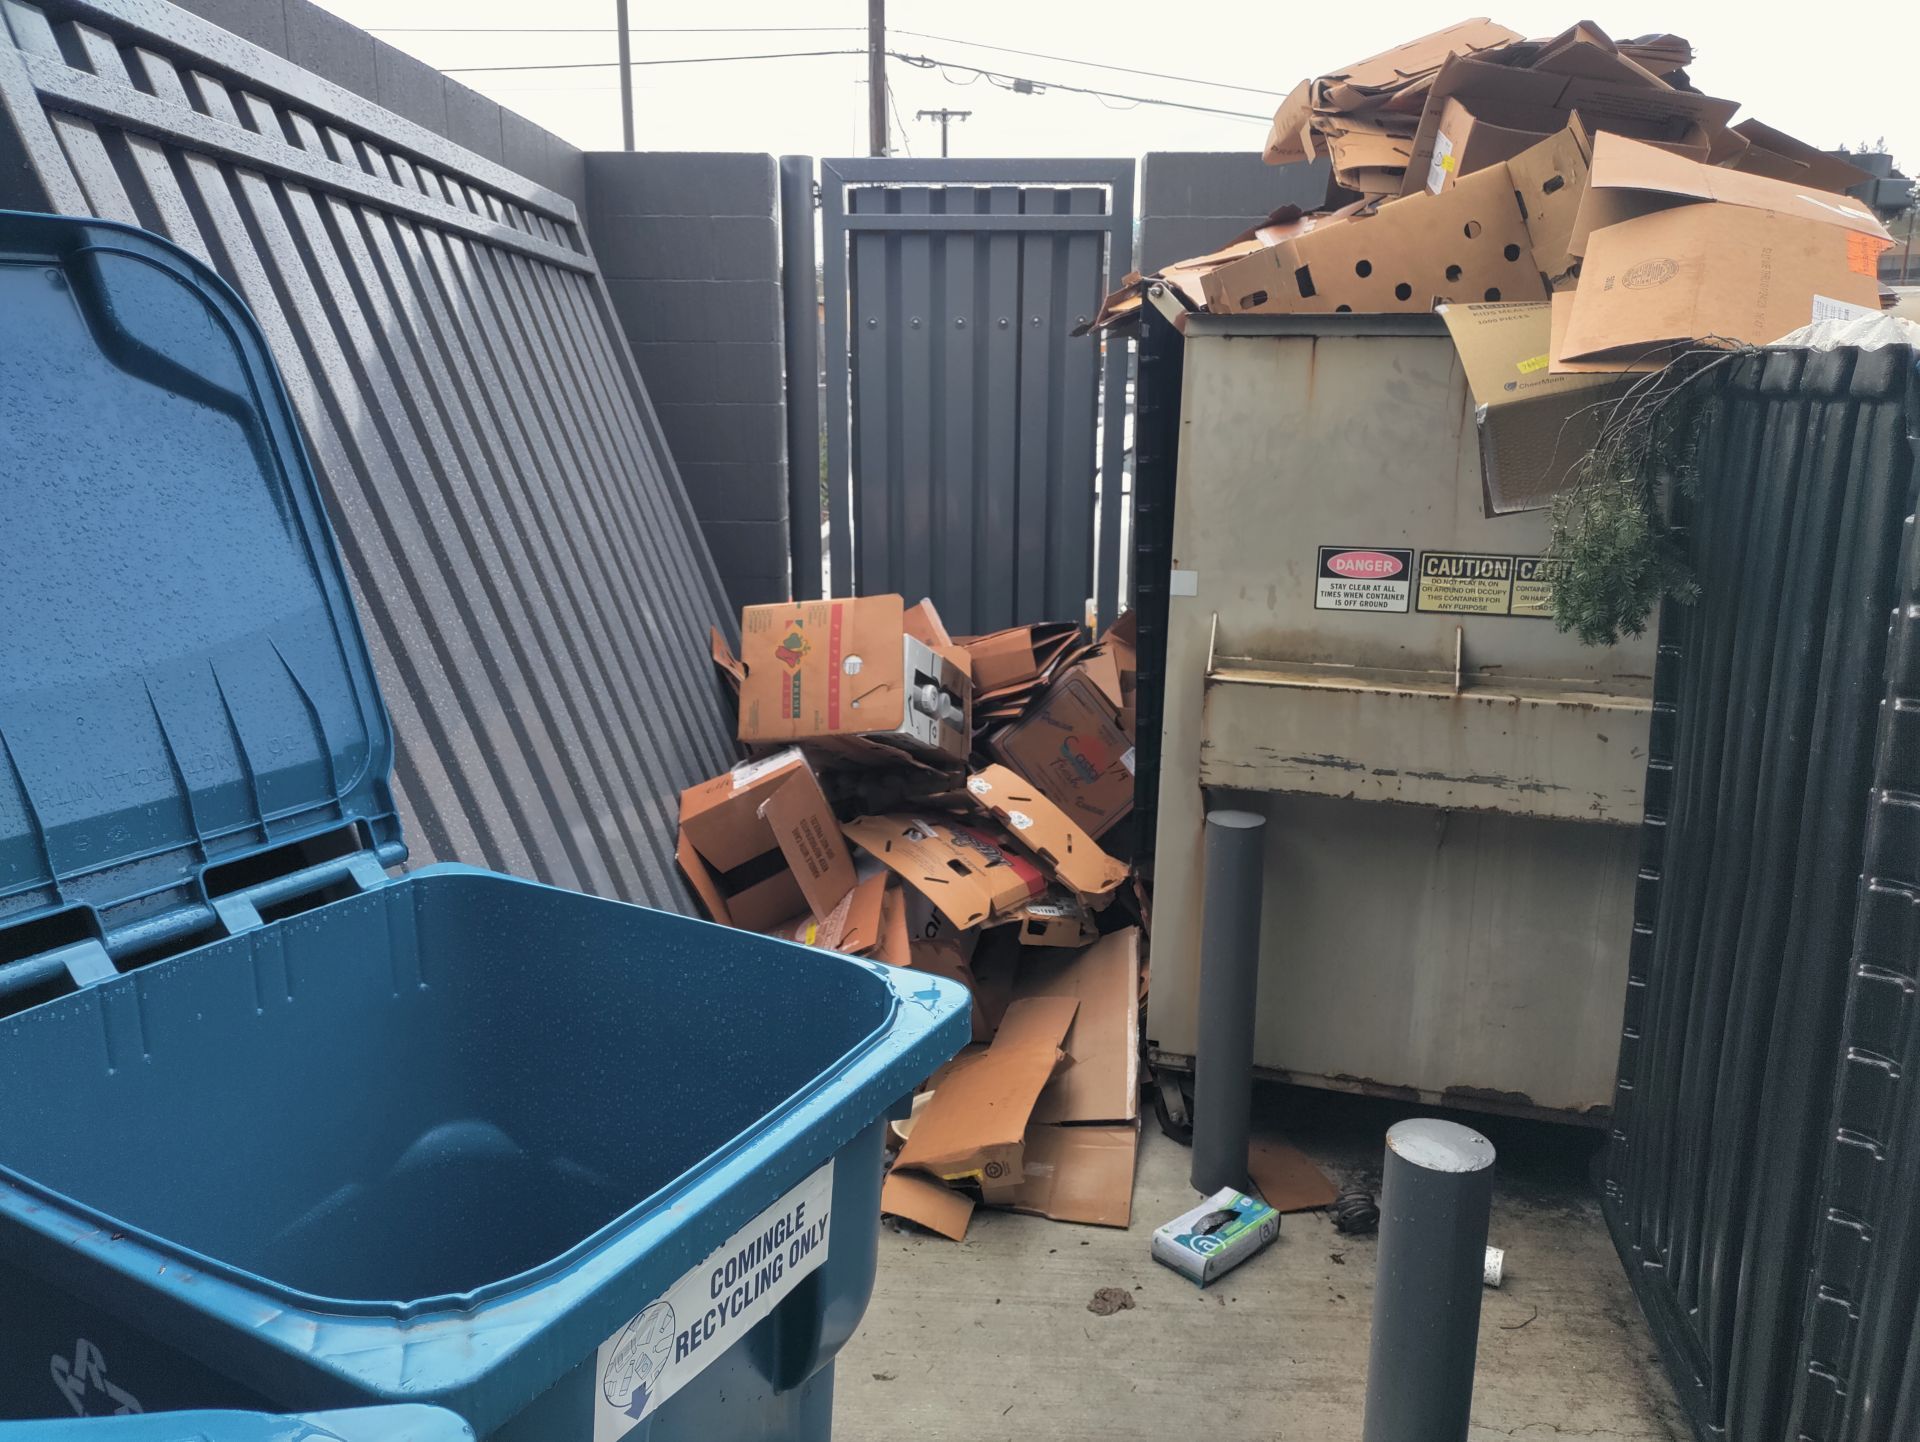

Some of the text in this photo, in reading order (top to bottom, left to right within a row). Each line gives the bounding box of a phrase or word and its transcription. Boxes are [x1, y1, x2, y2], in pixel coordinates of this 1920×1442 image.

[1335, 559, 1393, 572] DANGER
[1426, 558, 1507, 578] CAUTION
[1320, 590, 1341, 598] TIMES
[1365, 592, 1405, 600] CONTAINER
[1477, 588, 1507, 596] OCCUPY
[1359, 600, 1388, 608] GROUND
[1444, 595, 1484, 603] CONTAINER
[711, 1201, 806, 1300] COMINGLE
[675, 1213, 829, 1365] RECYCLING ONLY
